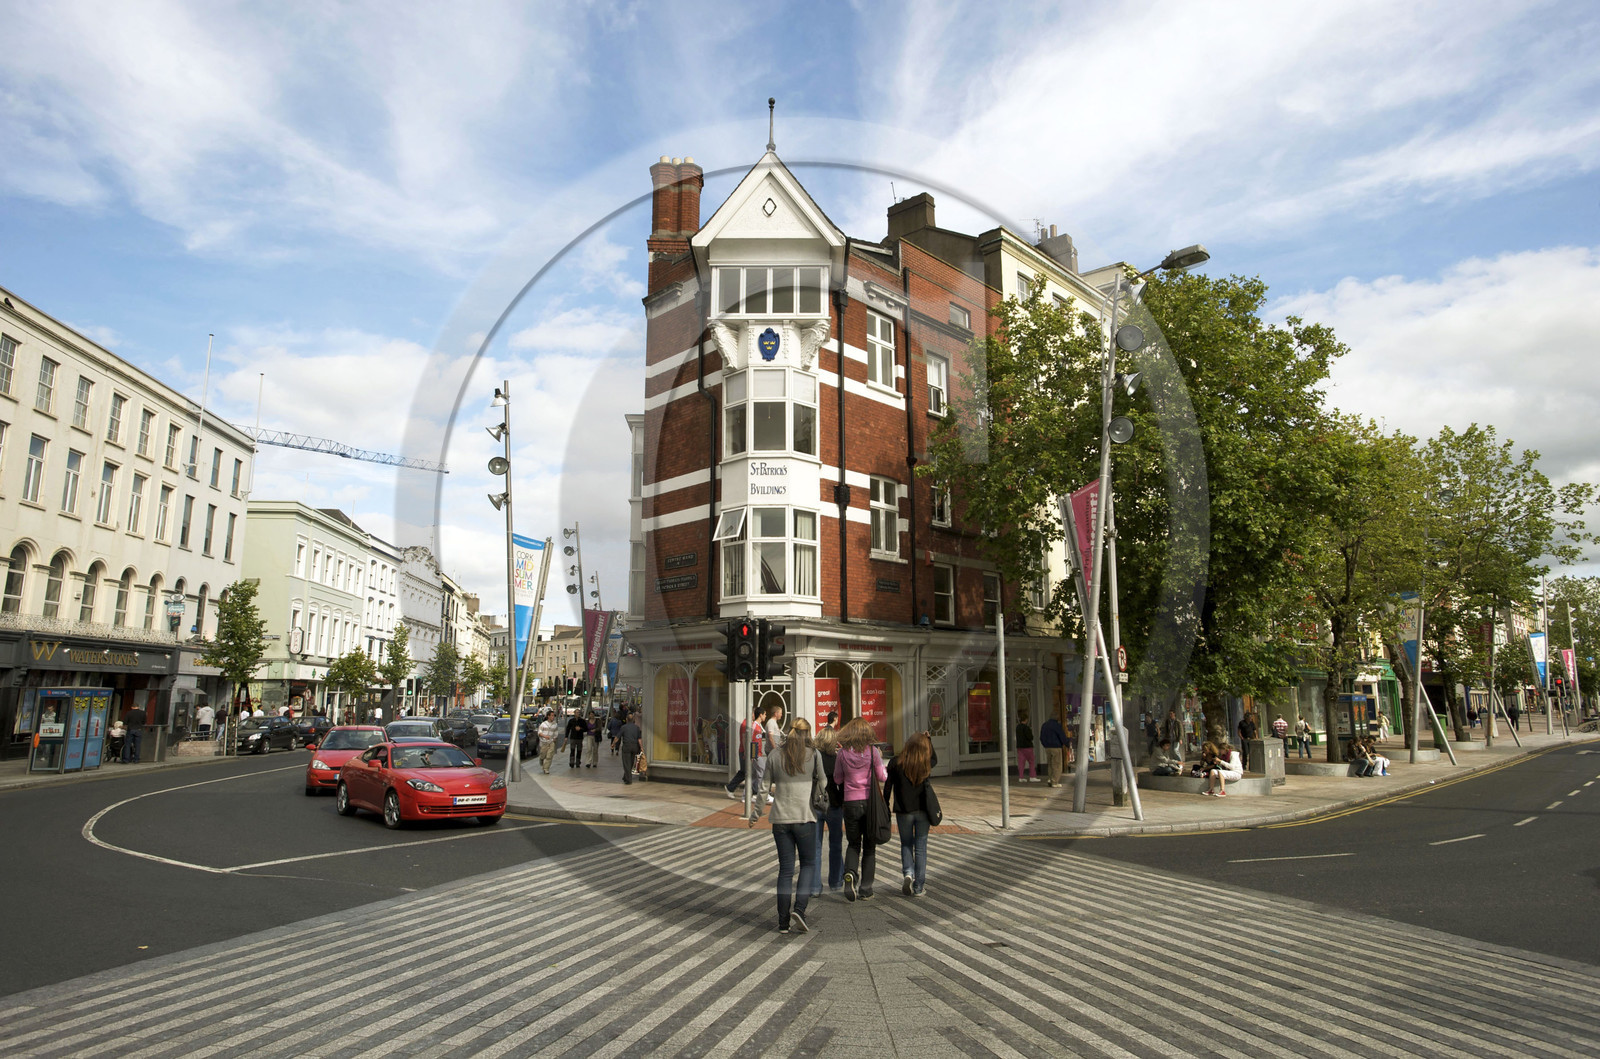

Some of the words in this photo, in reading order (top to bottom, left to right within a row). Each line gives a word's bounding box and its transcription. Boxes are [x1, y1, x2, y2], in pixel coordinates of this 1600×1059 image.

[516, 550, 534, 561] CORK
[516, 559, 534, 571] MID
[515, 568, 533, 580] SUM
[515, 579, 534, 590] MER
[30, 640, 62, 661] W
[70, 650, 139, 667] WATERSTONE'S
[817, 690, 831, 698] great
